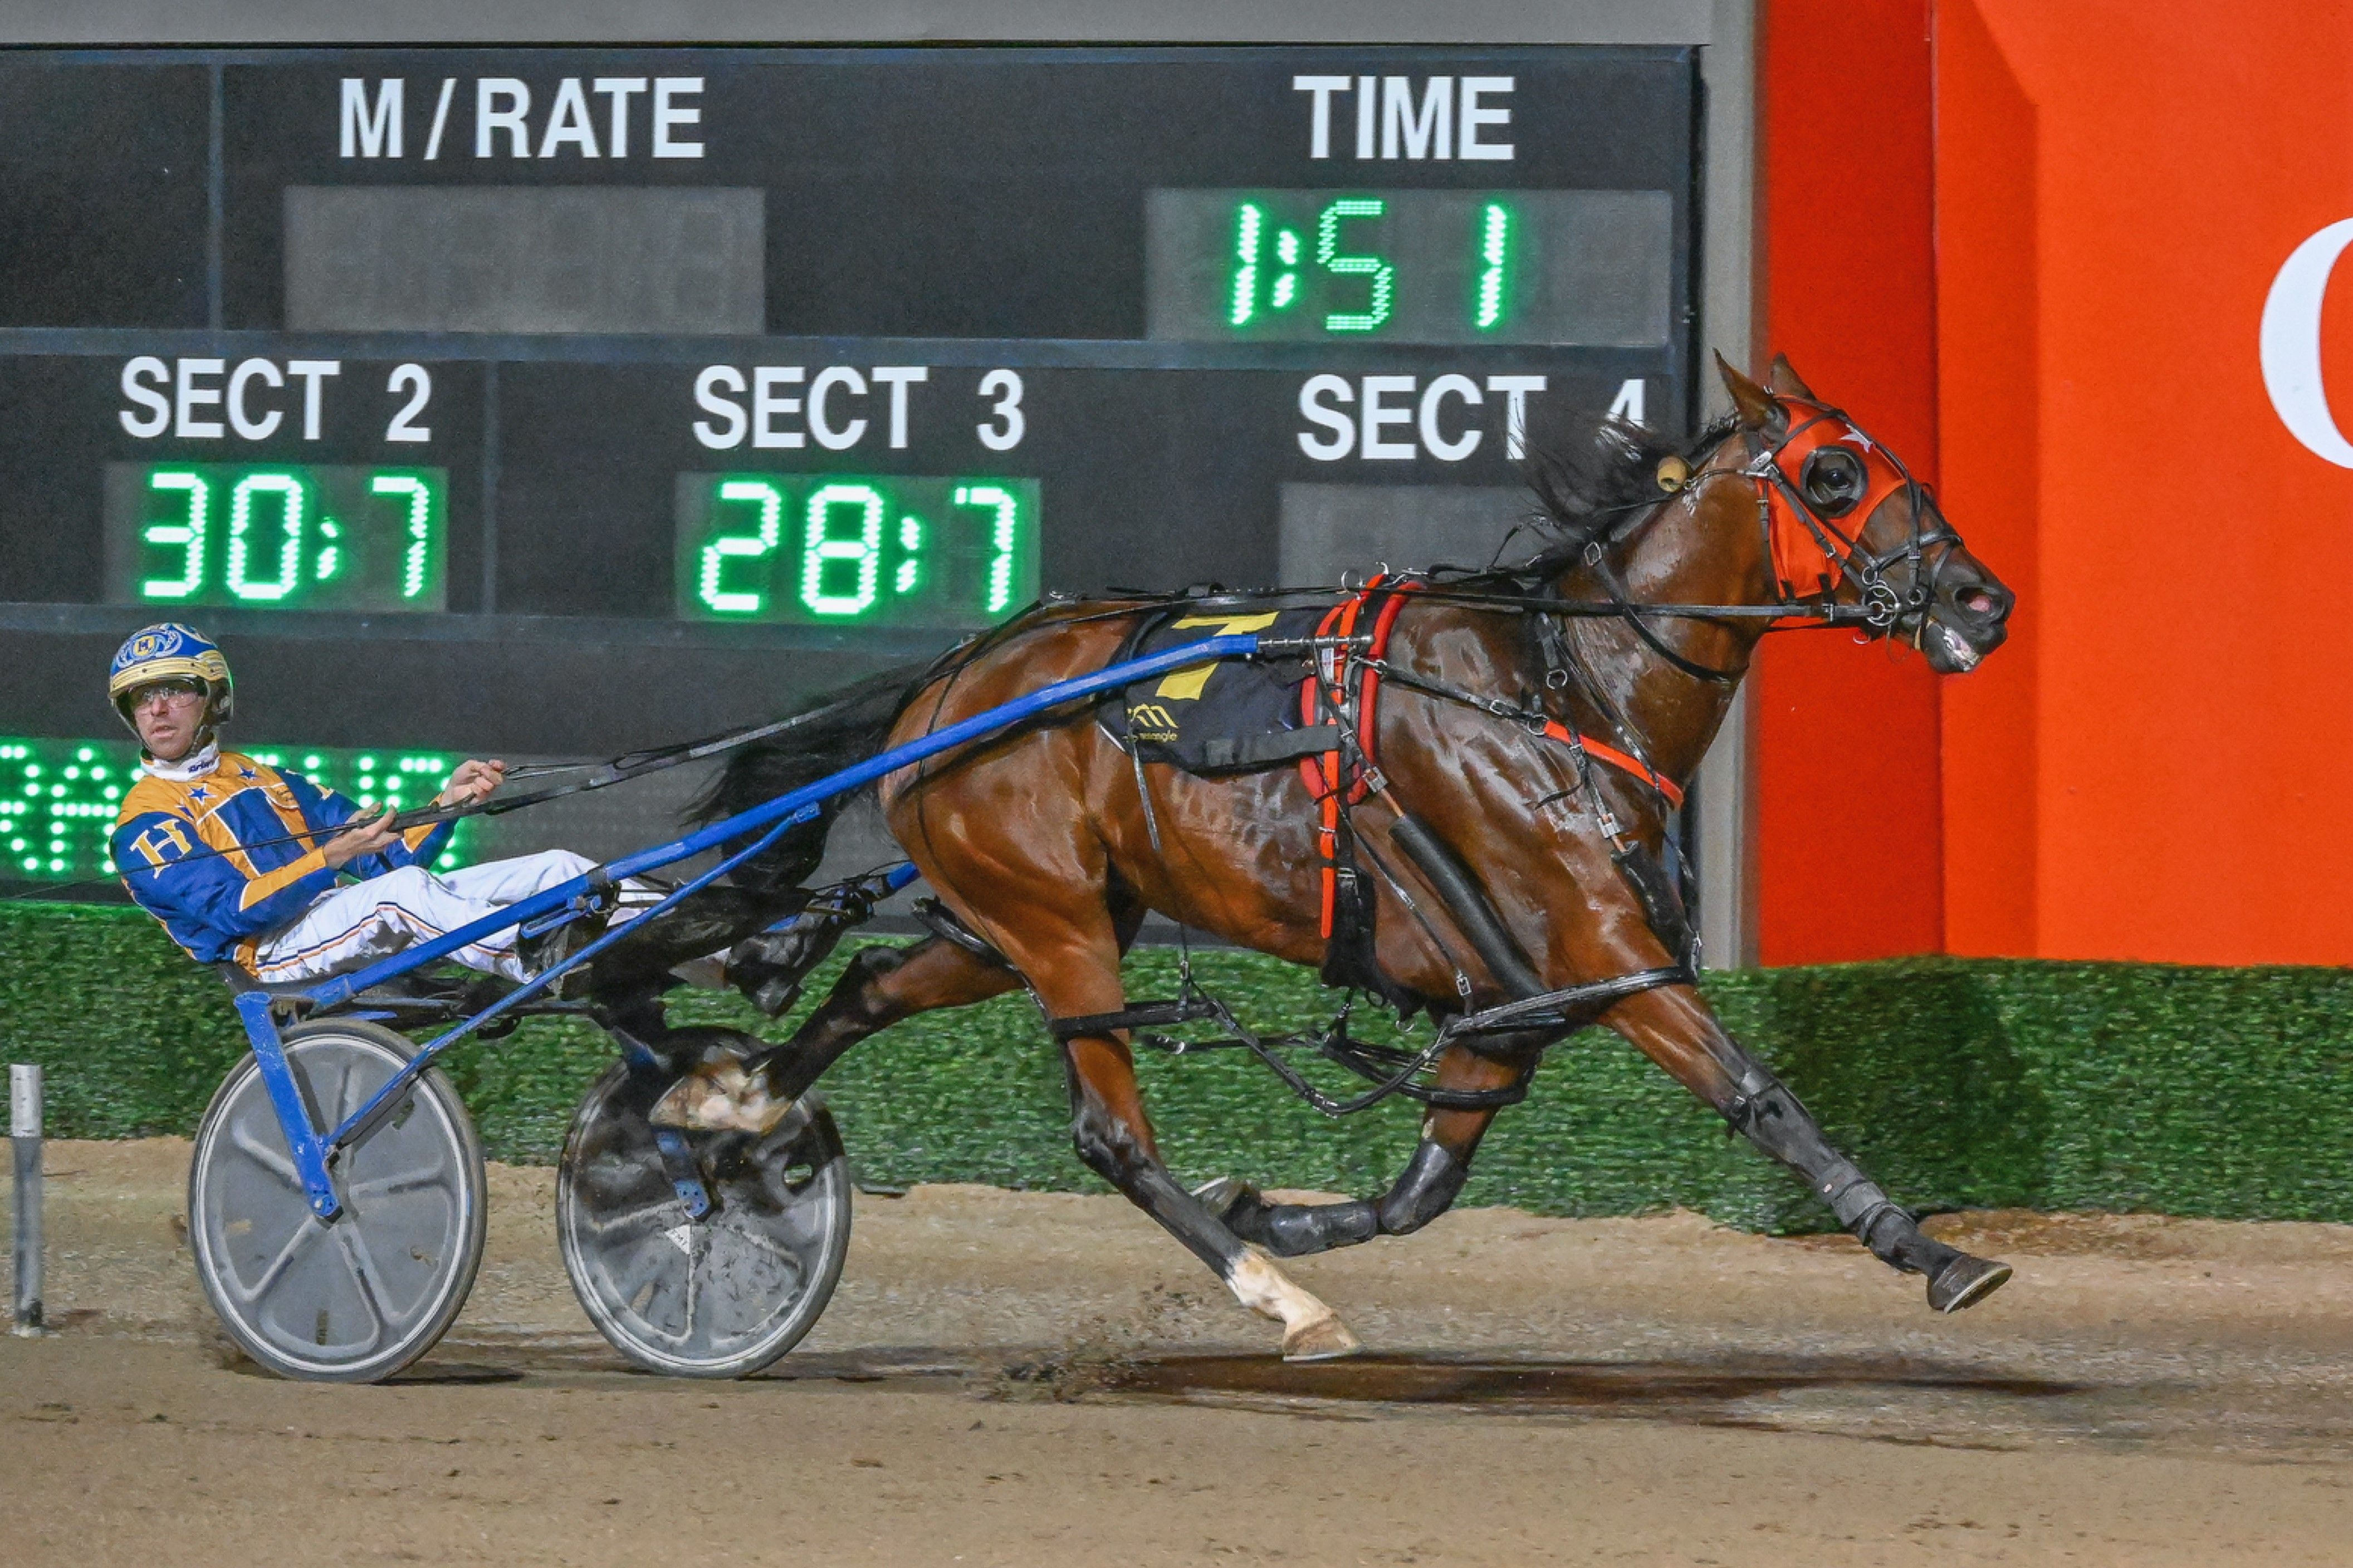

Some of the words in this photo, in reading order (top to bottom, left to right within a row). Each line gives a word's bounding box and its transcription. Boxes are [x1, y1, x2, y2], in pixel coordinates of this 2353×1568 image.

[1293, 76, 1515, 160] TIME
[120, 356, 340, 439] SECT
[386, 364, 432, 442] 2
[693, 365, 928, 450] SECT
[977, 369, 1025, 450] 3
[1297, 374, 1547, 461] SECT
[129, 818, 193, 879] H
